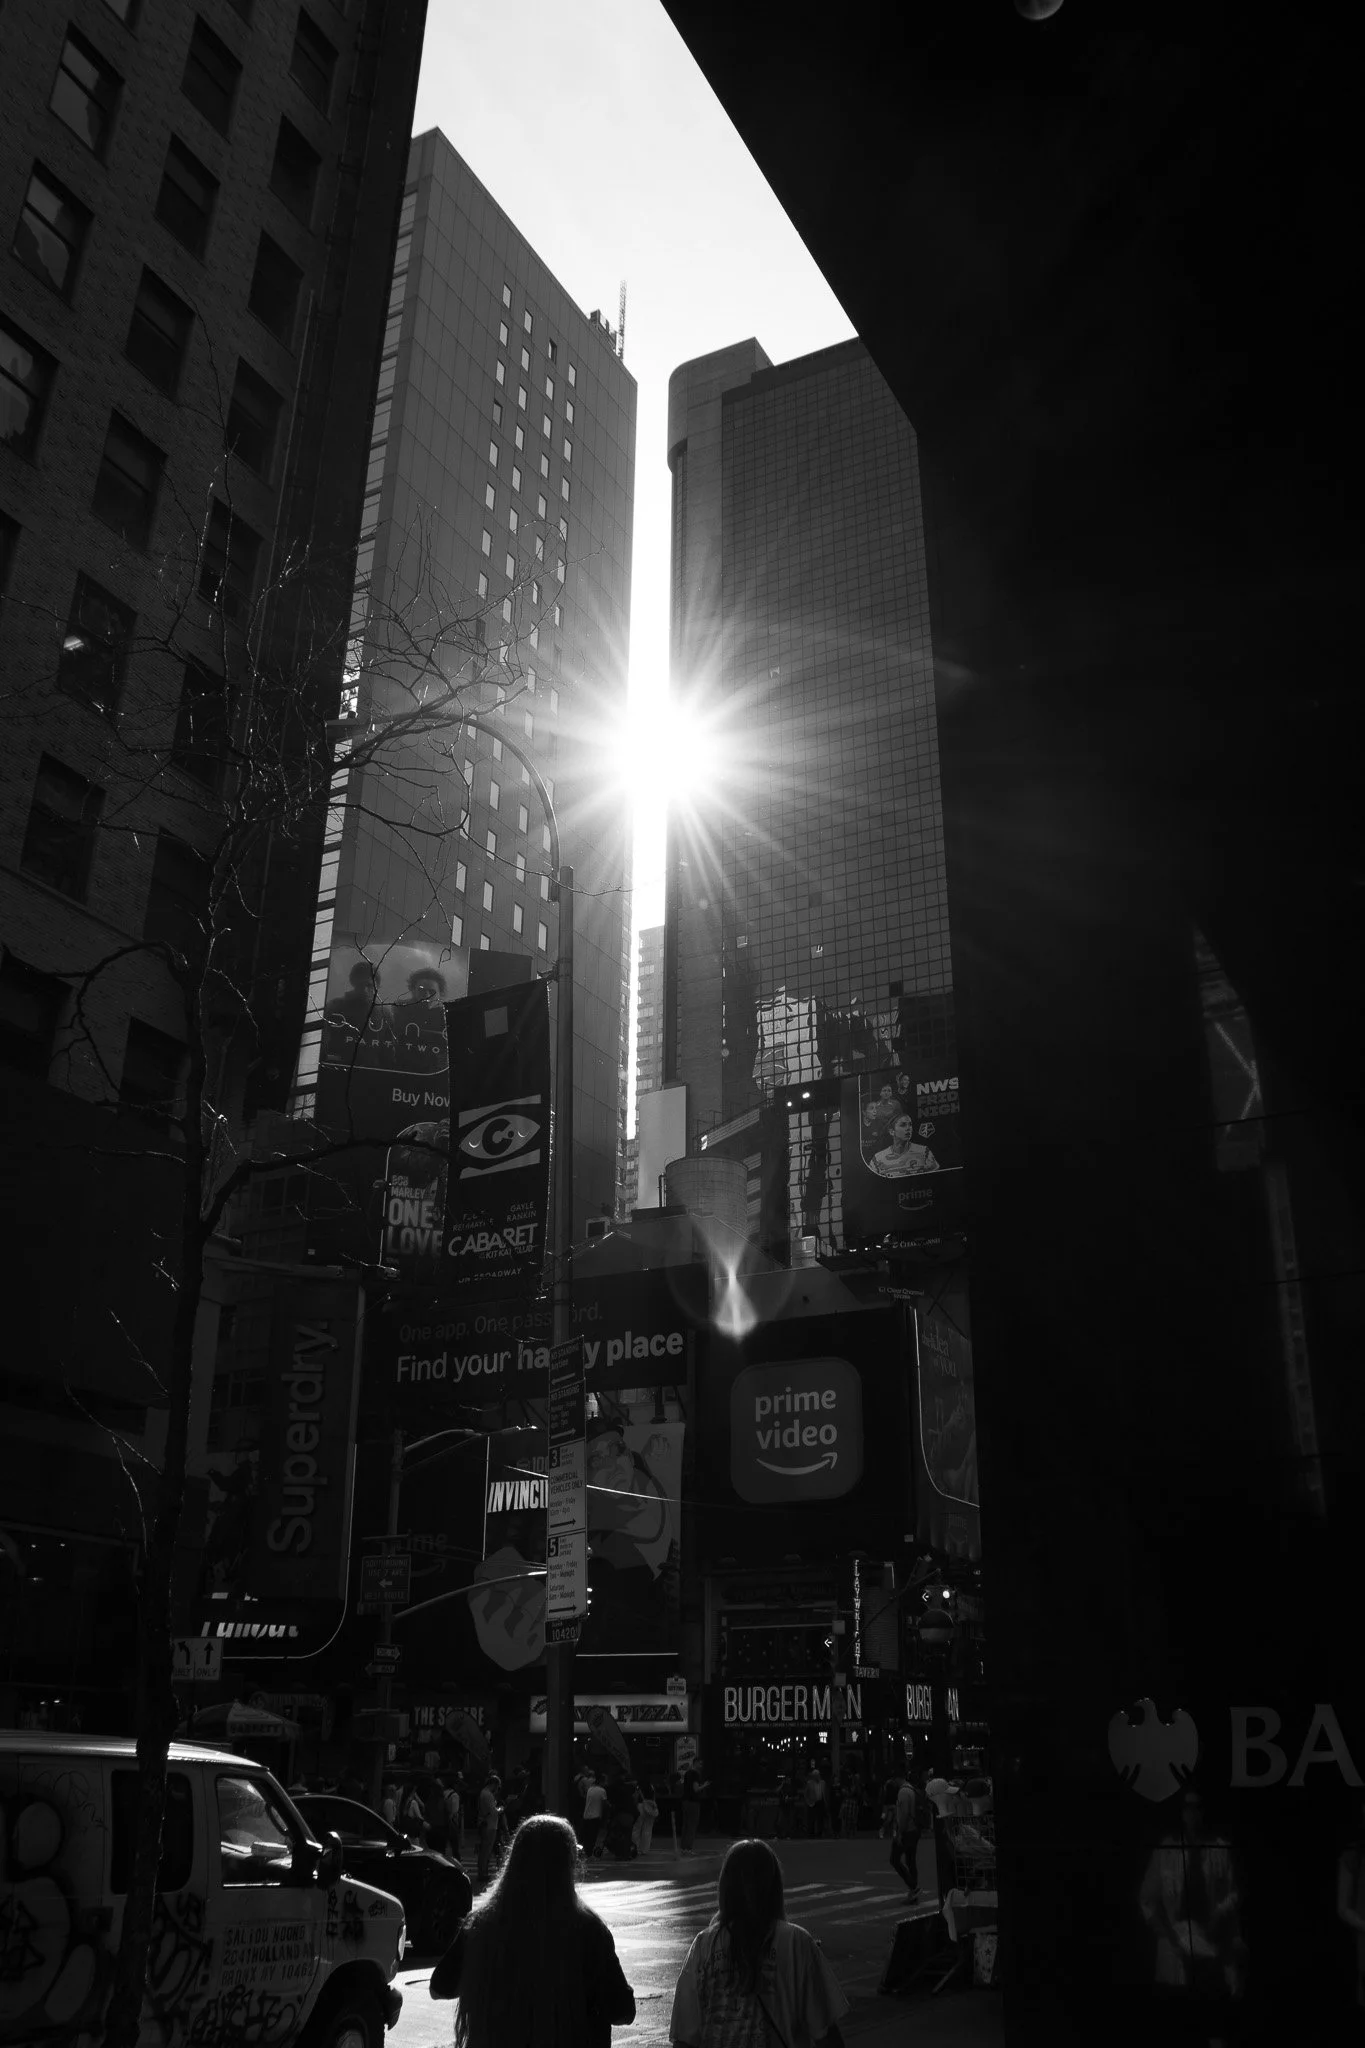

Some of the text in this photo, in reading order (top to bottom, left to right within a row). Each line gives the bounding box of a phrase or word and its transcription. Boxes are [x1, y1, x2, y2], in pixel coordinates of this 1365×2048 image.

[346, 1036, 440, 1055] PART TWO
[392, 1088, 420, 1107] Buy
[391, 1174, 409, 1187] BOB
[390, 1186, 427, 1200] MARLEY
[898, 1188, 934, 1202] prime
[388, 1198, 435, 1228] ONE
[506, 1210, 537, 1222] RANKIN
[509, 1201, 535, 1213] GAYLE
[386, 1226, 444, 1257] LOVE
[448, 1222, 539, 1257] CABARET
[485, 1250, 498, 1260] KIT
[399, 1301, 603, 1343] One app. One passrd.
[396, 1331, 684, 1384] Find your hay place
[754, 1386, 837, 1423] prime
[754, 1418, 838, 1450] video
[551, 1449, 558, 1467] 3
[550, 1538, 557, 1557] 5
[197, 1667, 218, 1678] ONLY
[414, 1706, 436, 1727] THE
[617, 1704, 684, 1722] PIZZA
[1228, 1702, 1365, 1790] BA
